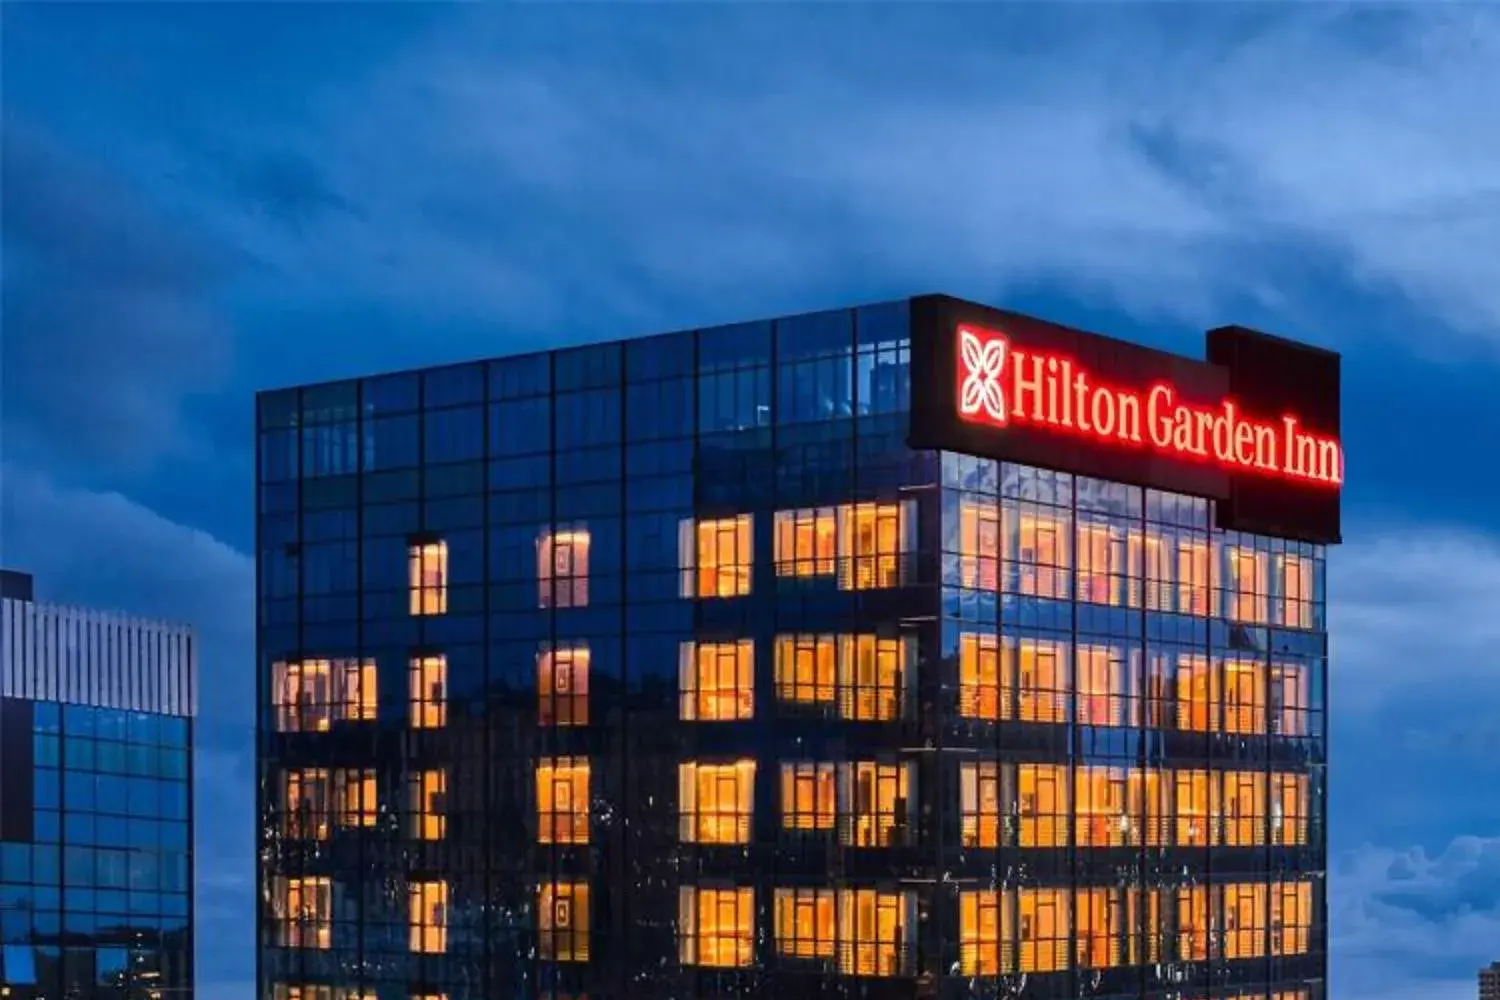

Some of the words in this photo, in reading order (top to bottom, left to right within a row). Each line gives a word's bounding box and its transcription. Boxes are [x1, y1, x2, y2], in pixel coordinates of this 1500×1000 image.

[1011, 351, 1141, 441] Hilton
[1148, 385, 1278, 471] Garden
[1282, 416, 1342, 482] Inn
